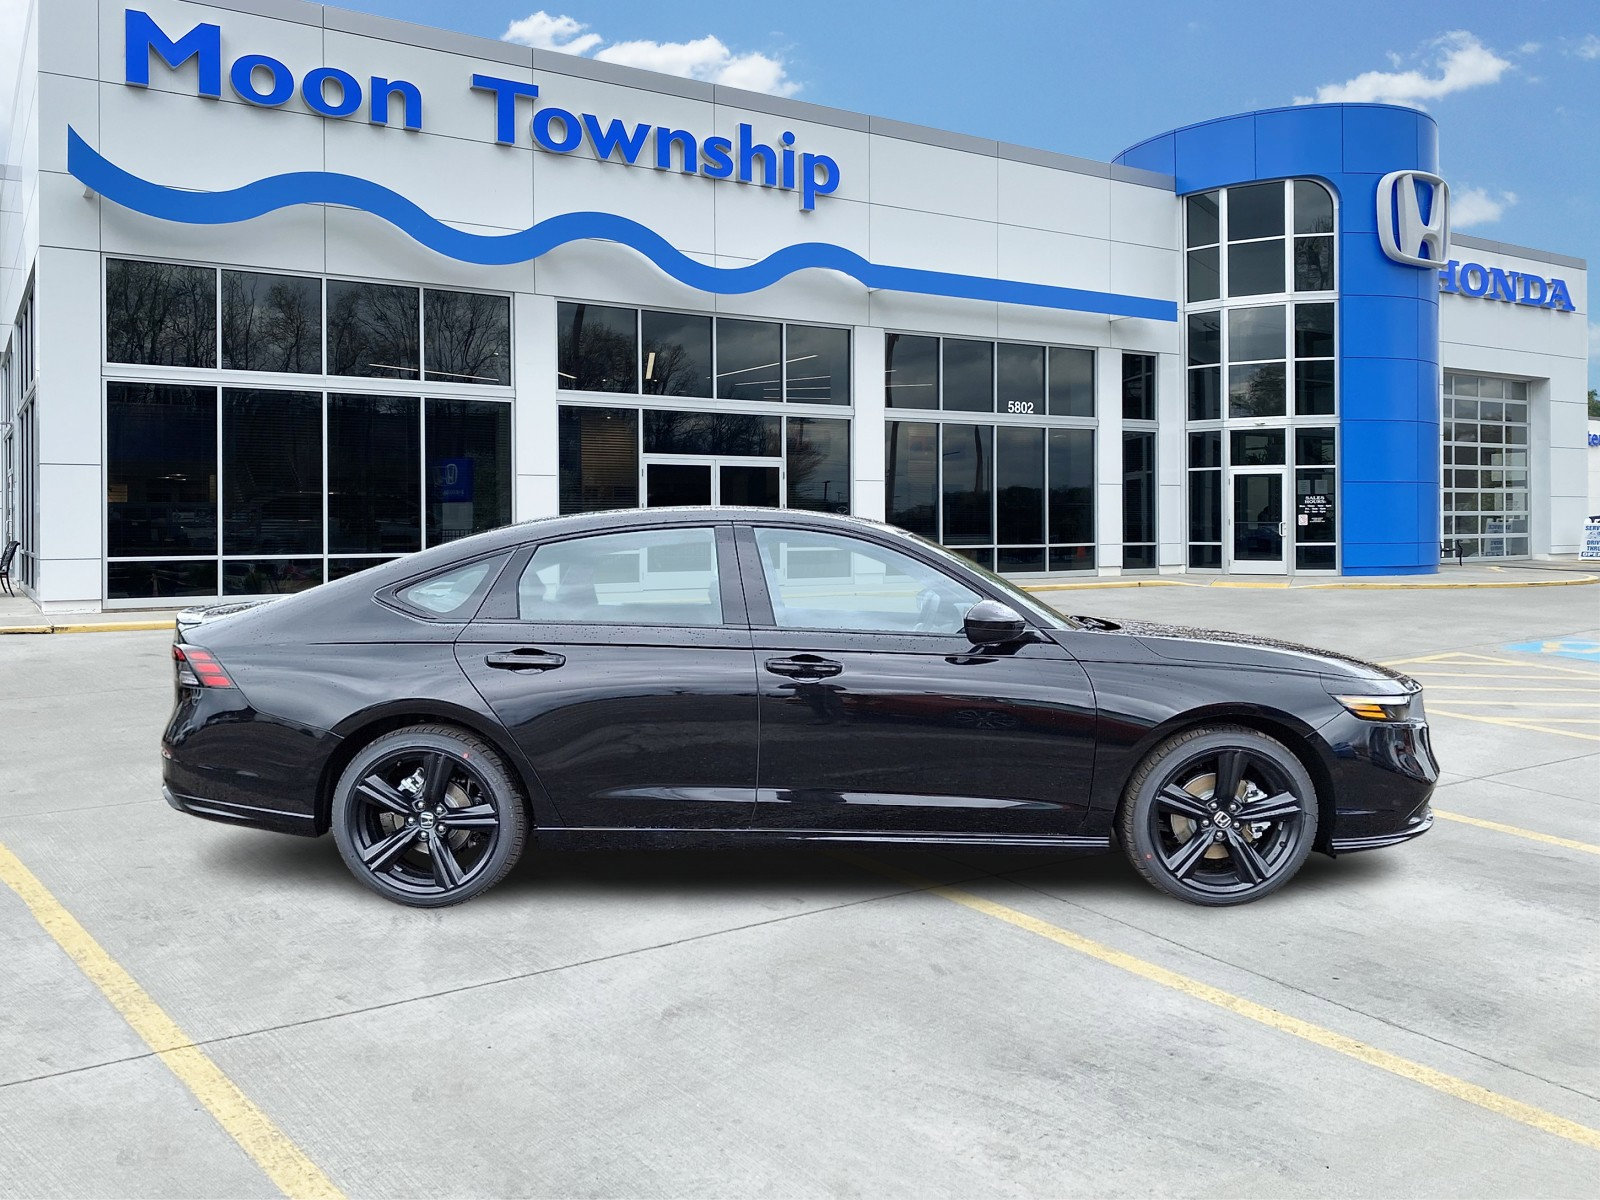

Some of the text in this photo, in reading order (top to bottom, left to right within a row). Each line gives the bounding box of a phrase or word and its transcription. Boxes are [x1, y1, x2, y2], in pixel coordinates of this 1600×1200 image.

[125, 8, 841, 212] Moon Township
[1439, 259, 1576, 311] HONDA
[1007, 400, 1034, 414] 5802
